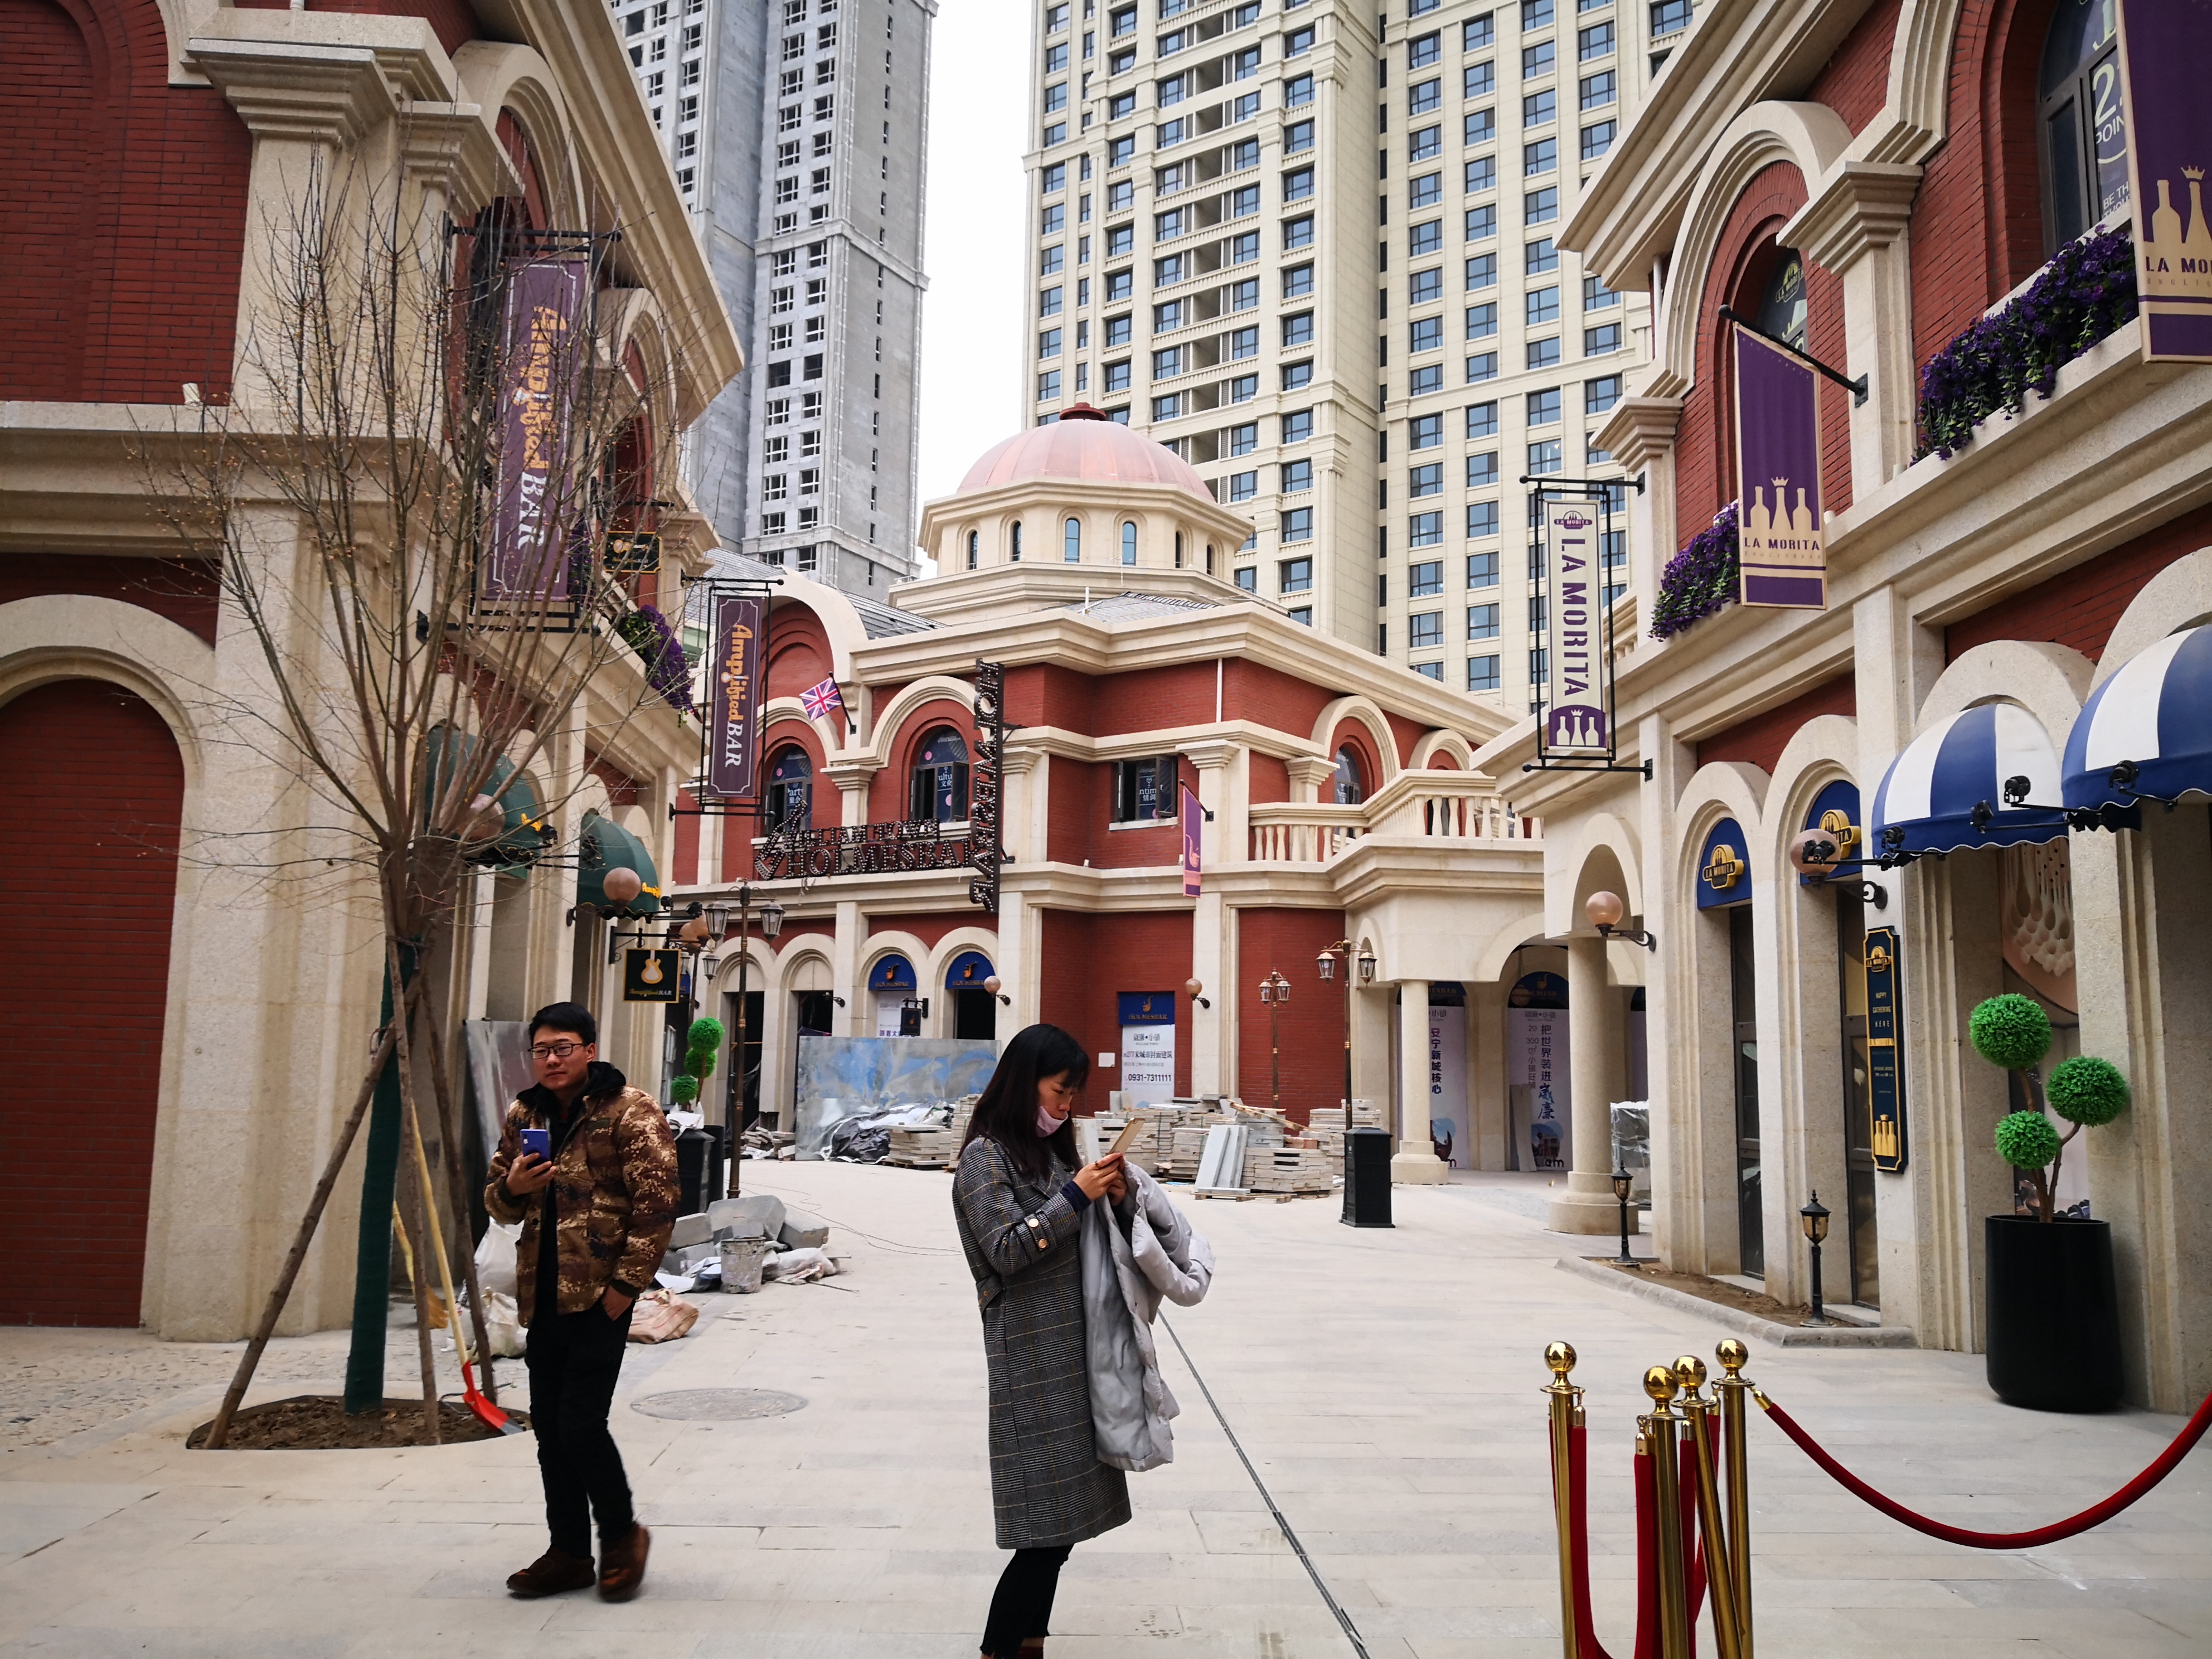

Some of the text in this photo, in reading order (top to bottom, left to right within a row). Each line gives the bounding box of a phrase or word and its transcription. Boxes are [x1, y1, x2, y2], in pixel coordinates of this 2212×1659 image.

[2103, 192, 2115, 210] BE
[2146, 256, 2212, 274] LA MO
[518, 471, 547, 550] BAR
[1744, 537, 1820, 551] LA MORITA
[1561, 539, 1586, 573] LA
[1563, 582, 1589, 696] MORITA
[721, 624, 753, 768] Amplified BAR
[1706, 866, 1713, 878] LA
[1128, 1074, 1171, 1082] 0931-7311111
